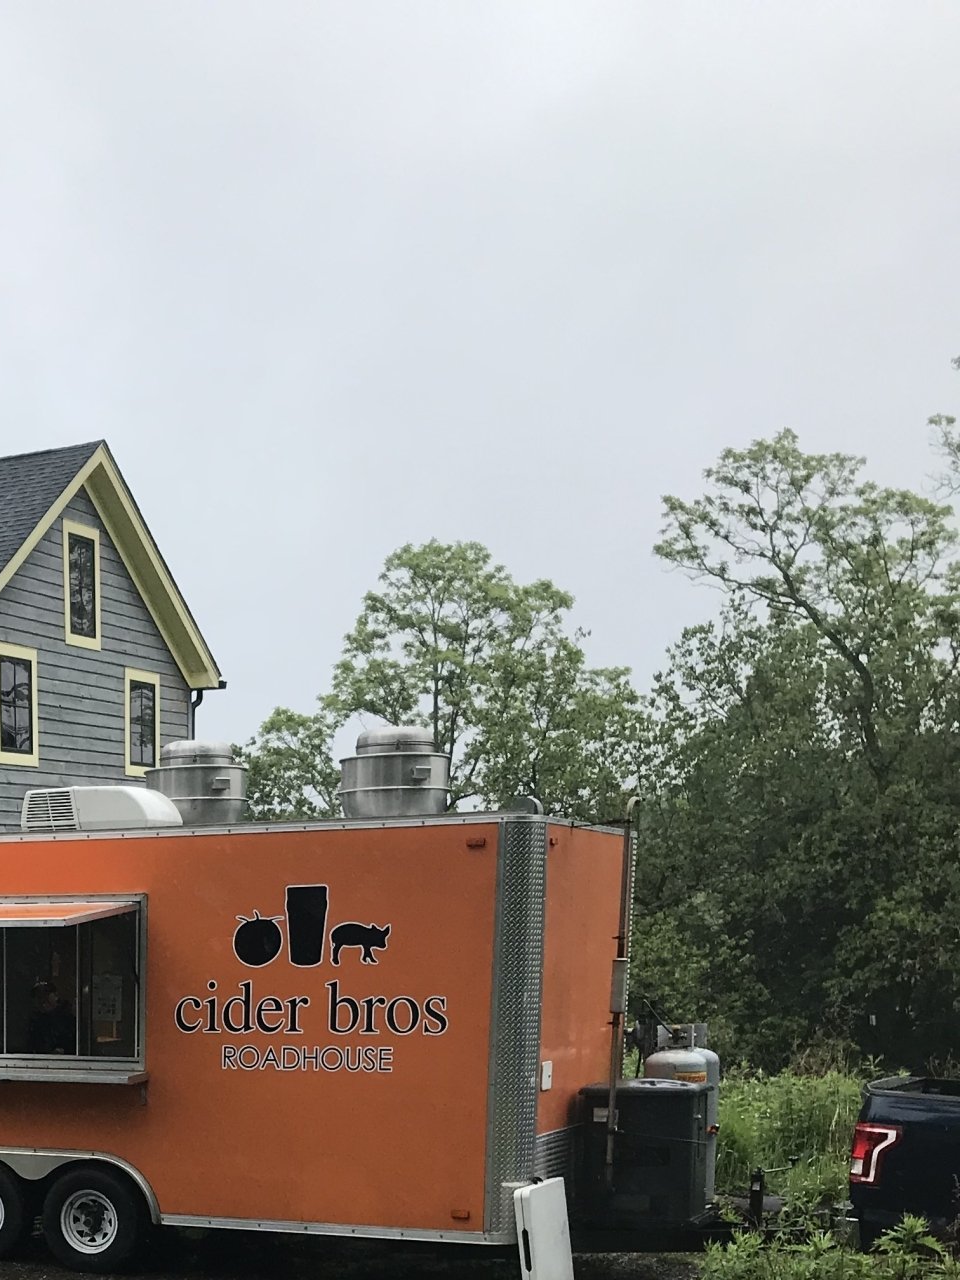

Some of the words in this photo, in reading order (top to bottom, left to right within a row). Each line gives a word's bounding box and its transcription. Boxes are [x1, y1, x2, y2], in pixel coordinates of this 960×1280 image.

[174, 980, 310, 1035] cider
[325, 980, 449, 1036] bros
[221, 1045, 394, 1073] ROADHOUSE
